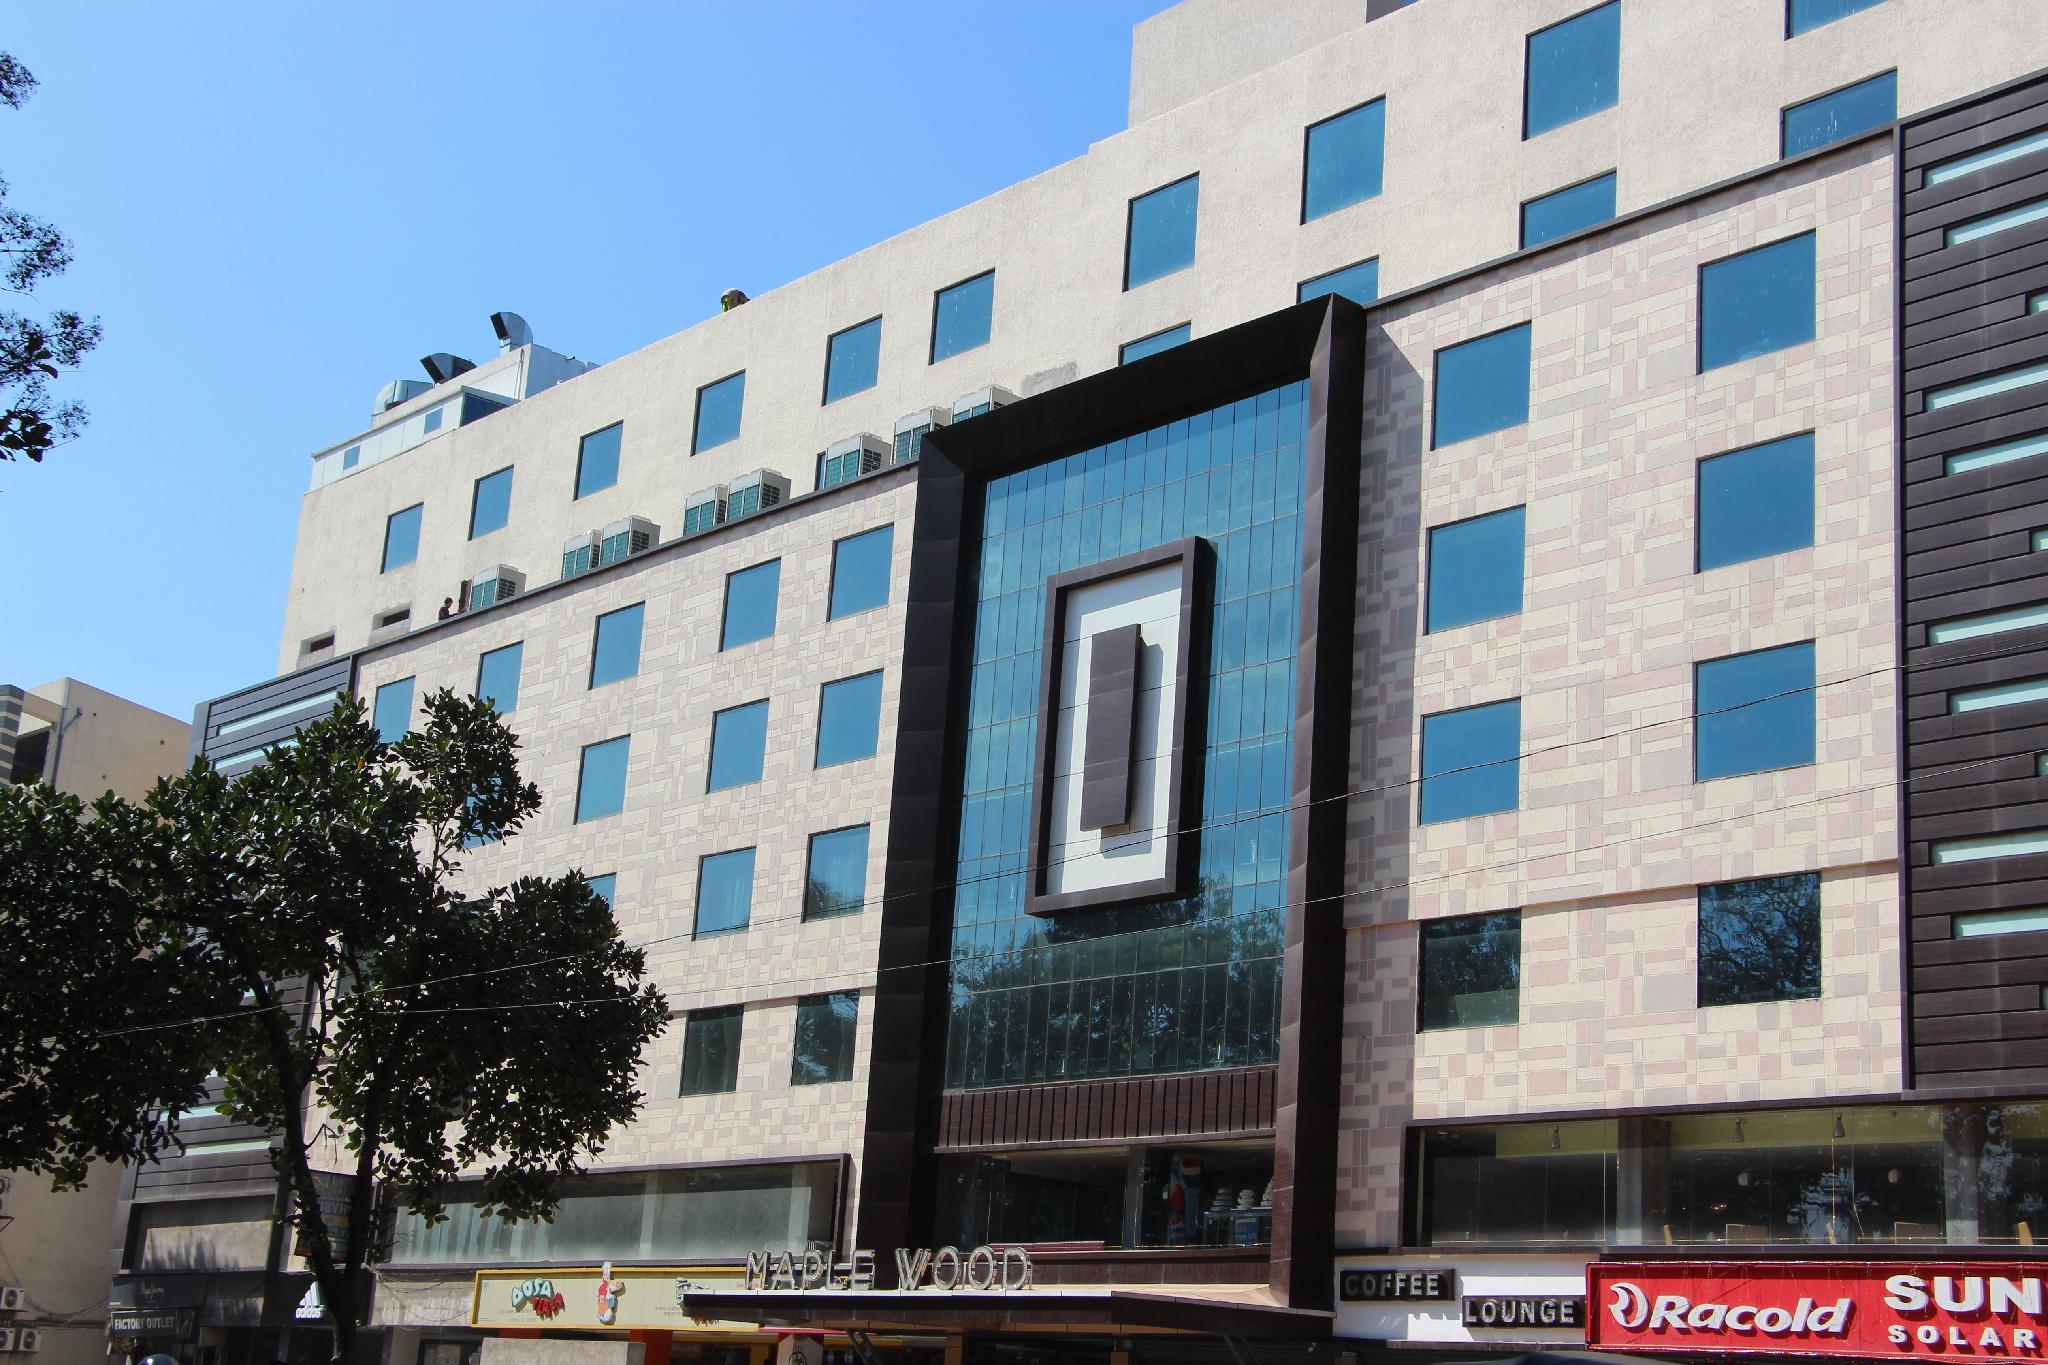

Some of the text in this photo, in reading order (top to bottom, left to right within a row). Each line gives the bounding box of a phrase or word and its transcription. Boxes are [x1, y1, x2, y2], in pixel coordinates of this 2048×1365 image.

[745, 1246, 1031, 1290] MAPLE WOOD
[512, 1278, 553, 1307] DOSA
[1345, 1273, 1440, 1297] COFFEE
[1884, 1274, 2042, 1314] SUN
[114, 1316, 175, 1330] FACTORY OUTLET
[1464, 1300, 1575, 1324] LOUNGE
[1649, 1295, 1852, 1333] Racold
[1887, 1324, 2037, 1349] SOLAR
